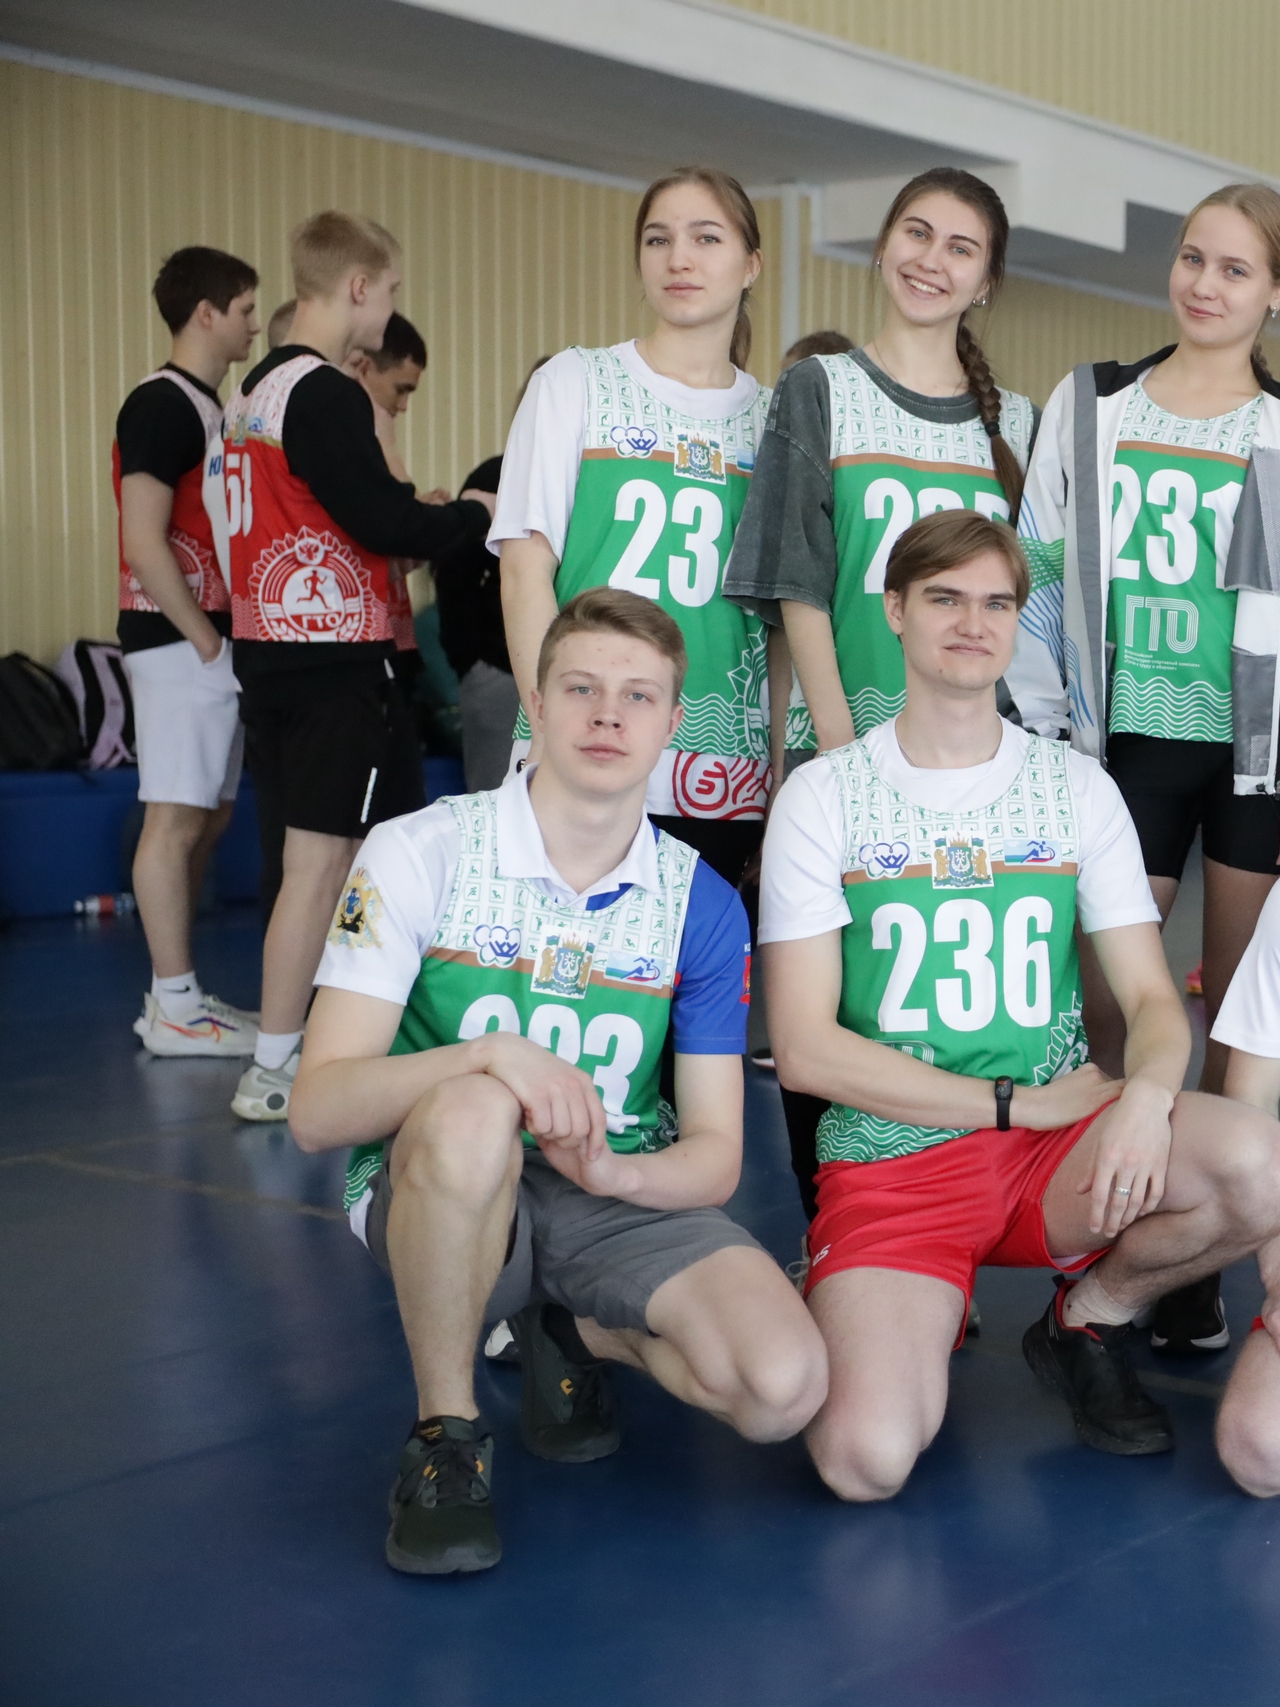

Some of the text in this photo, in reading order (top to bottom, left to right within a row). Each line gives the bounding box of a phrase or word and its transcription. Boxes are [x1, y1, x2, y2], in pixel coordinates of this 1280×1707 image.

[607, 479, 726, 607] 23
[1111, 464, 1243, 590] 231
[301, 612, 342, 630] ГТО
[1125, 594, 1199, 654] ГТО
[871, 896, 1053, 1032] 236
